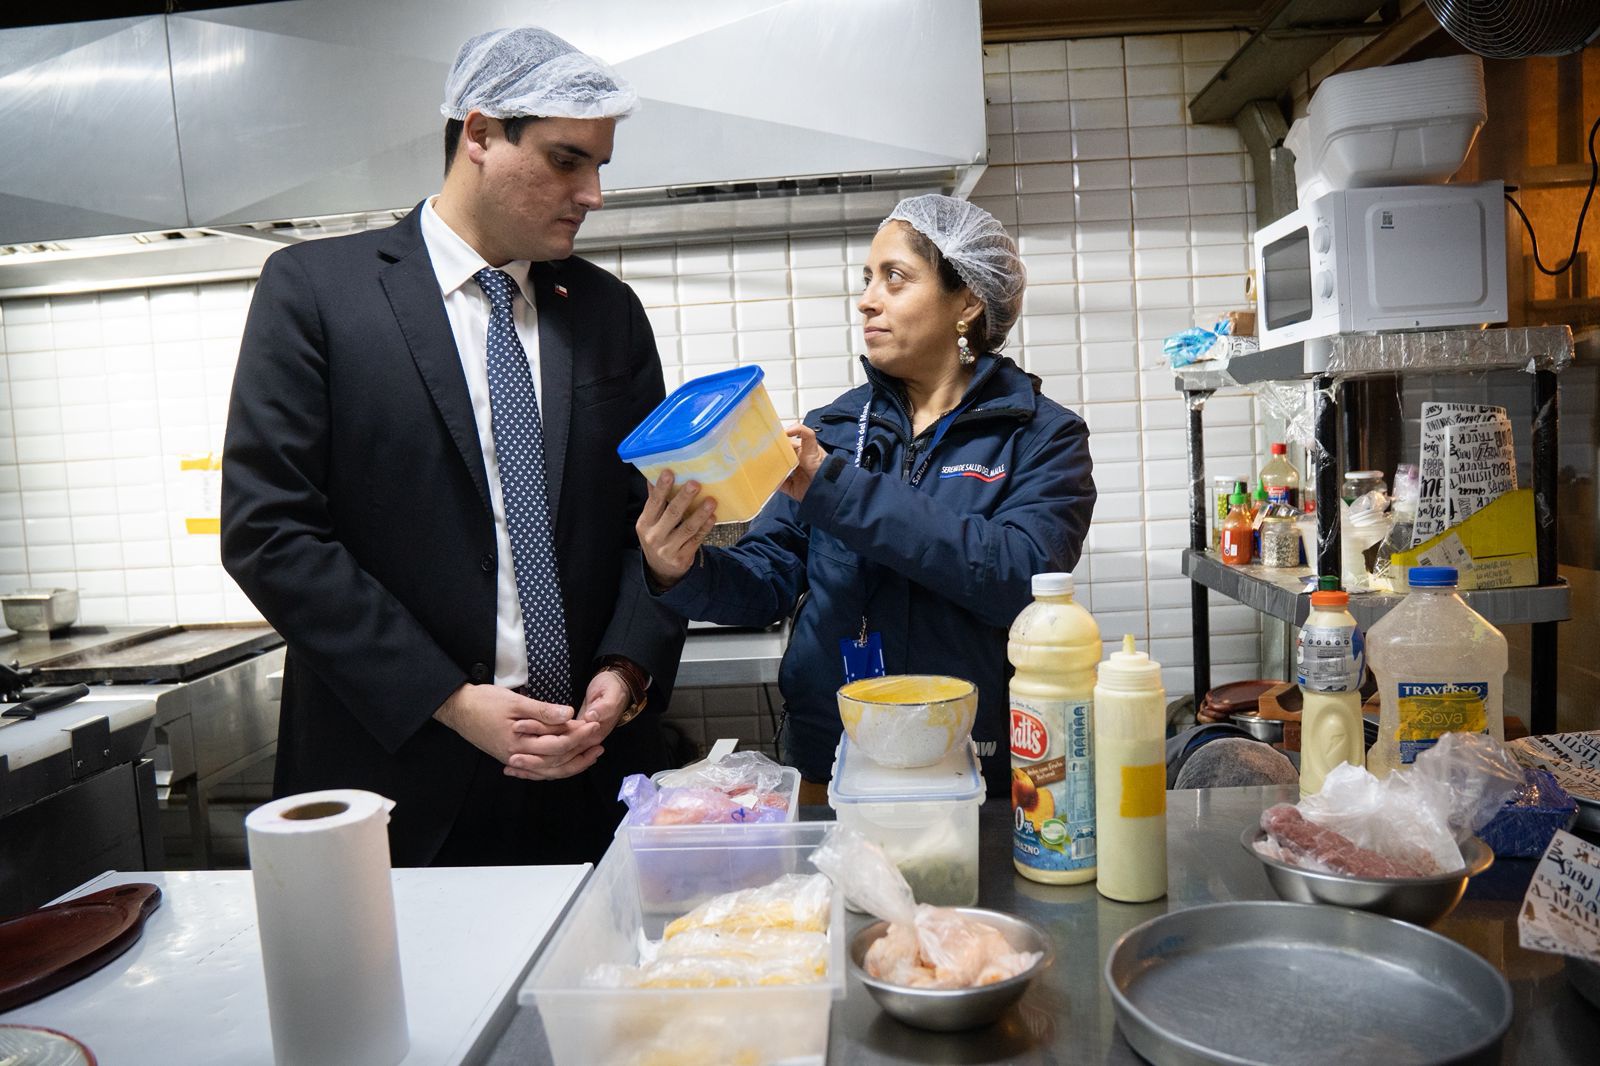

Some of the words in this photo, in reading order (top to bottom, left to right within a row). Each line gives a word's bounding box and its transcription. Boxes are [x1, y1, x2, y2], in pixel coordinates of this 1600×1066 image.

[858, 421, 866, 434] del
[912, 461, 929, 485] Salud
[1402, 685, 1482, 696] TRAVERSO
[1420, 708, 1464, 728] Soya
